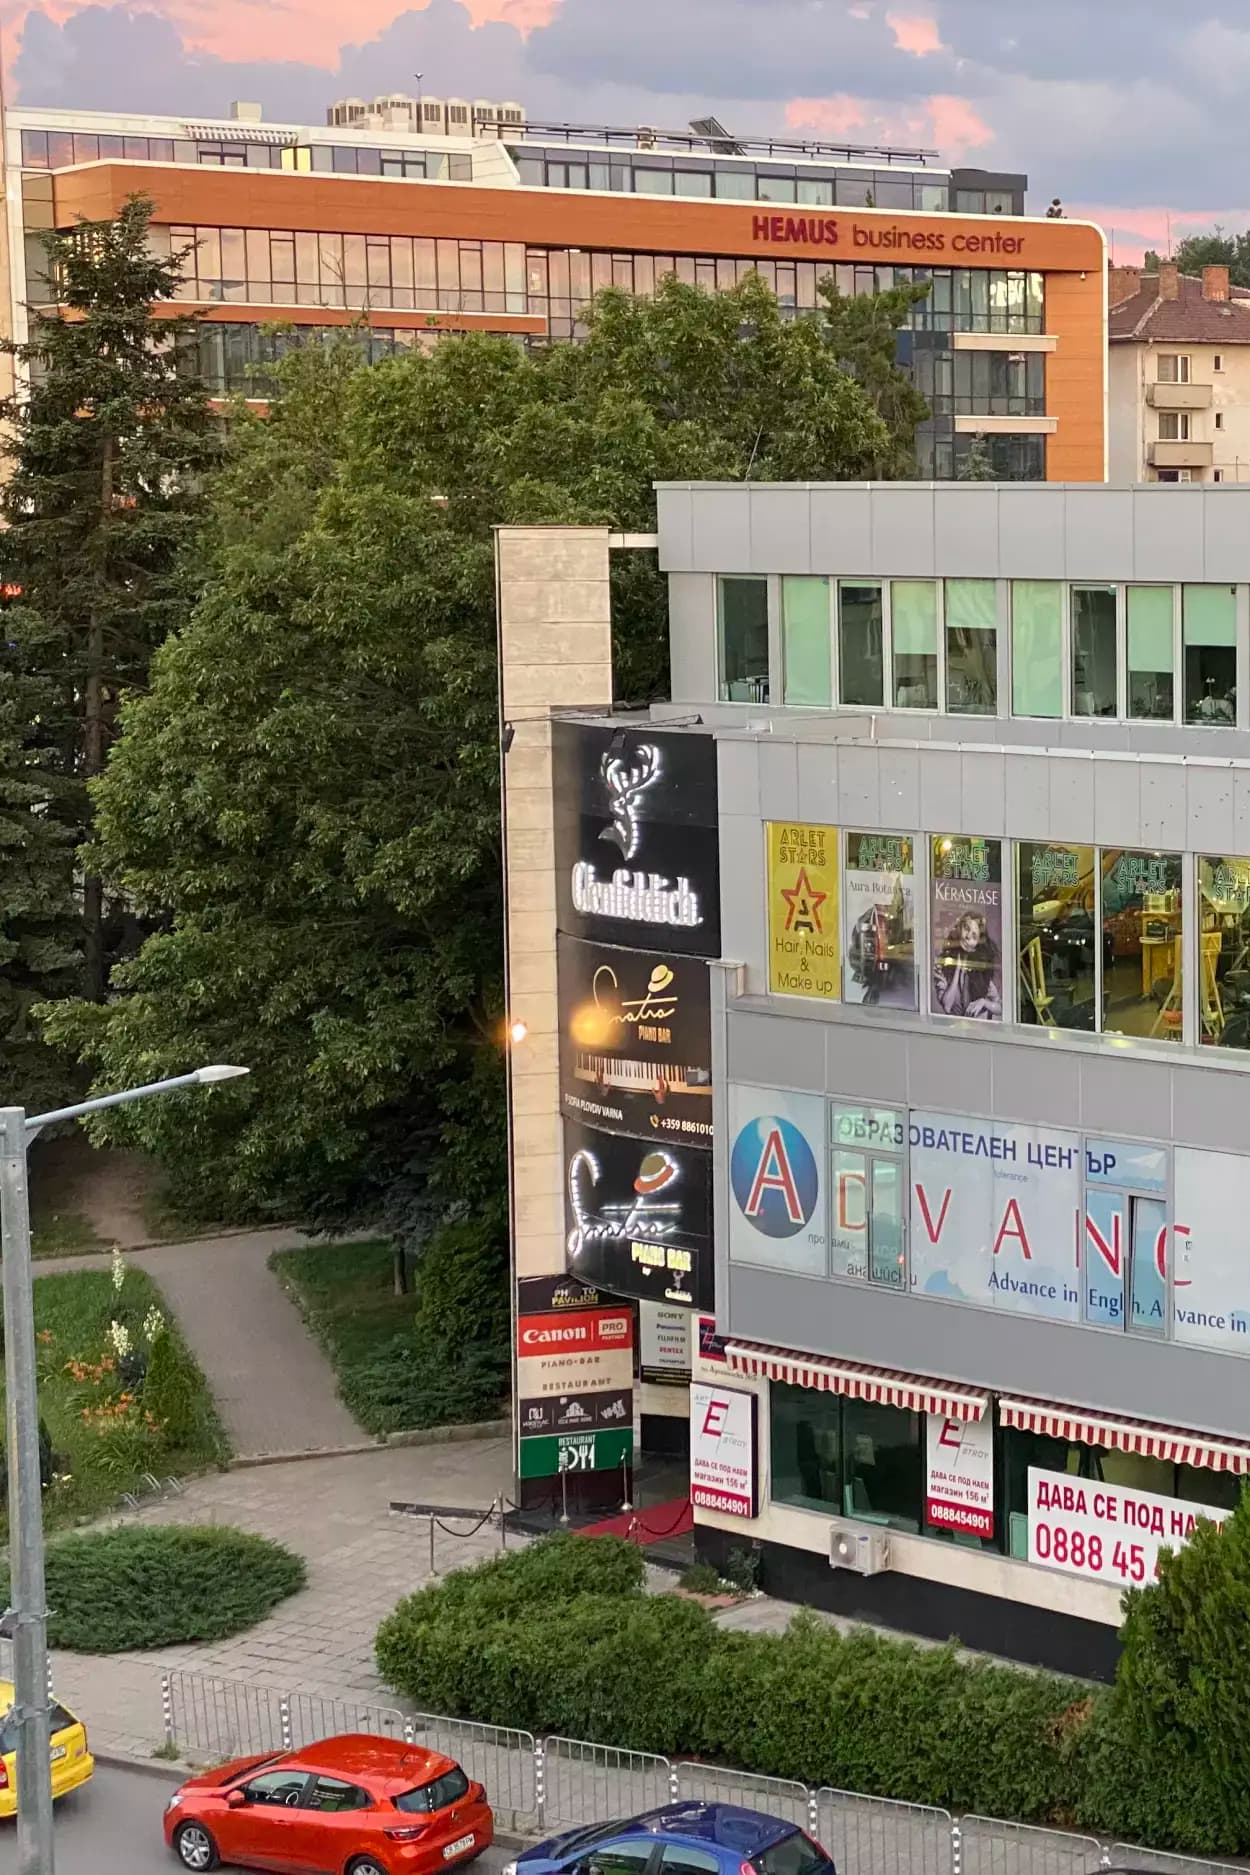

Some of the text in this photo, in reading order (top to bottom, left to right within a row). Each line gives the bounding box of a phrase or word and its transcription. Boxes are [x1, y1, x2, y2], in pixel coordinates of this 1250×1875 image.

[751, 215, 1025, 255] HEMUS business center
[779, 828, 826, 849] ARLET
[1032, 850, 1079, 870] ARLET
[1118, 856, 1168, 877] ARLET
[805, 940, 834, 958] Nails
[800, 957, 809, 972] &
[777, 972, 833, 994] Make up
[602, 1107, 623, 1120] VARNA
[660, 1118, 680, 1130] +359
[631, 1241, 666, 1268] PIANO
[551, 1294, 599, 1305] PAVILION
[987, 1270, 1057, 1300] Advance
[1063, 1283, 1079, 1304] in
[1231, 1312, 1248, 1333] in
[522, 1321, 625, 1344] Canon PRO
[542, 1377, 612, 1392] RESTAURANT
[702, 1400, 729, 1437] E
[558, 1434, 596, 1447] RESTAURANT
[694, 1458, 710, 1468] ДАВА
[710, 1461, 718, 1470] СЕ
[694, 1471, 724, 1484] магазин
[931, 1469, 990, 1490] ДАВА СЕ ПОД НАЕМ
[694, 1490, 748, 1515] 0888454901
[930, 1483, 963, 1499] магазин
[965, 1489, 979, 1501] 156
[931, 1503, 990, 1531] 0888454901
[1036, 1480, 1088, 1515] ДАВА
[1093, 1493, 1118, 1522] СЕ
[1123, 1500, 1165, 1538] ПОД
[1035, 1522, 1103, 1572] 0888
[1112, 1540, 1145, 1582] 45
